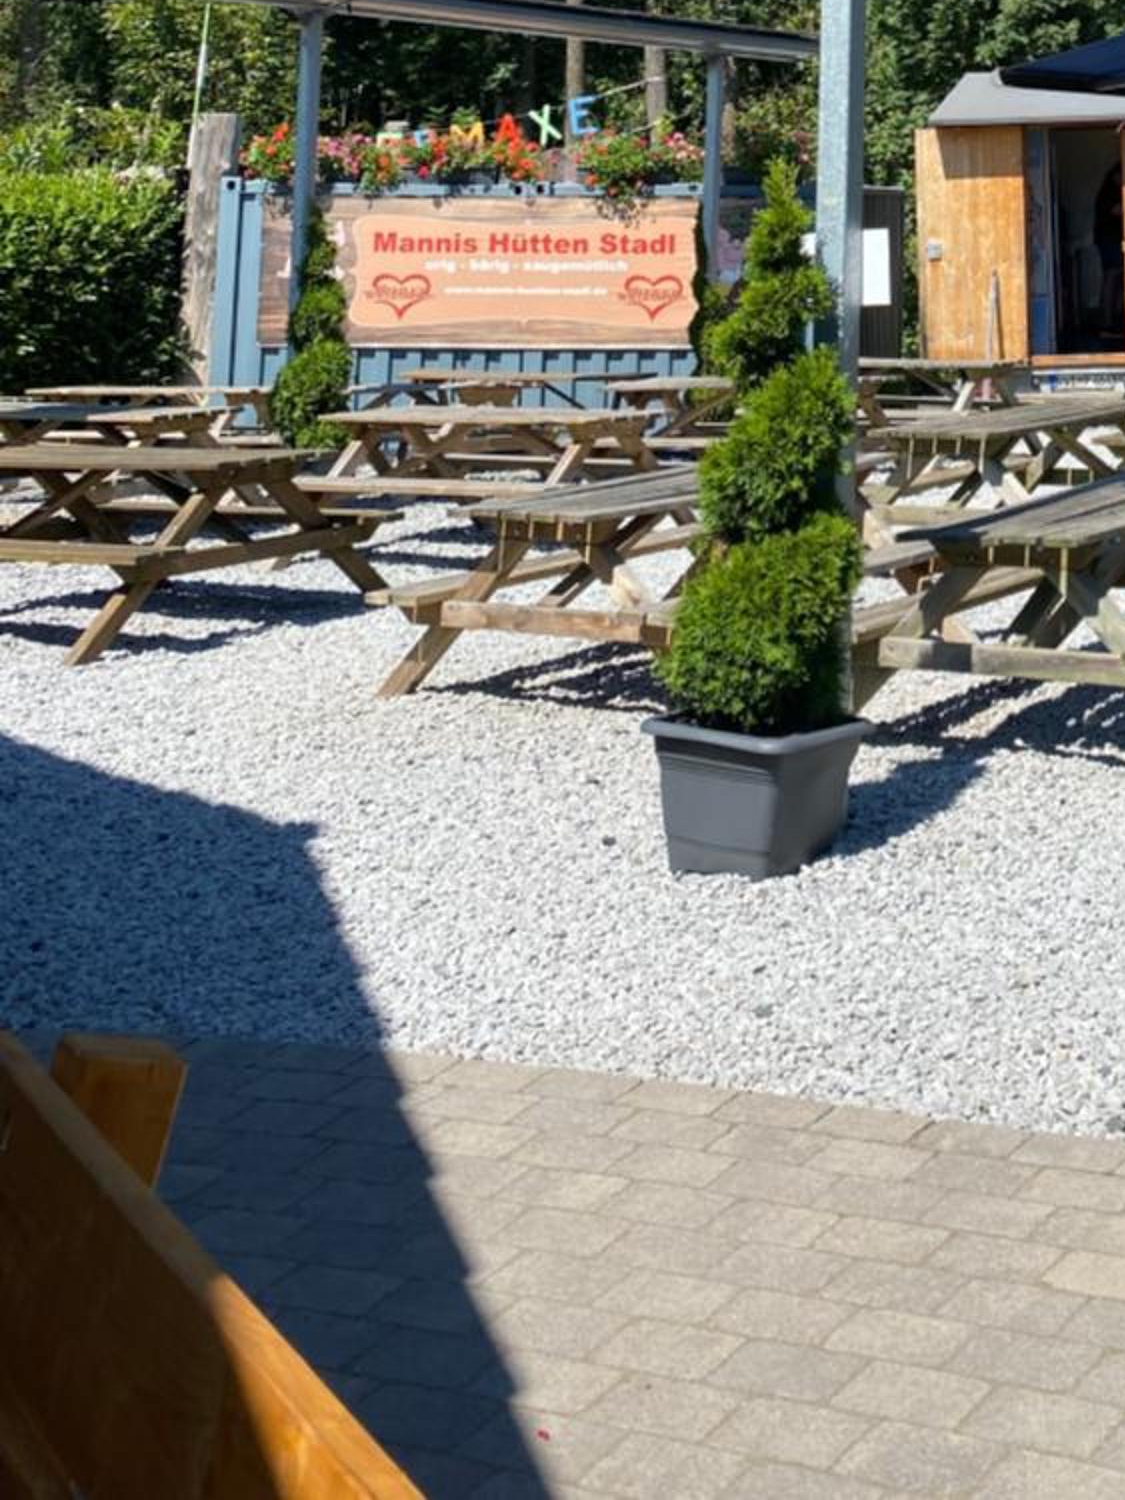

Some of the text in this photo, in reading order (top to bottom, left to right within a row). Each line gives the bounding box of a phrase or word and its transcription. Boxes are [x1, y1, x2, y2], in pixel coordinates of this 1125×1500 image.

[373, 231, 676, 255] Mannis Hütten Stadl
